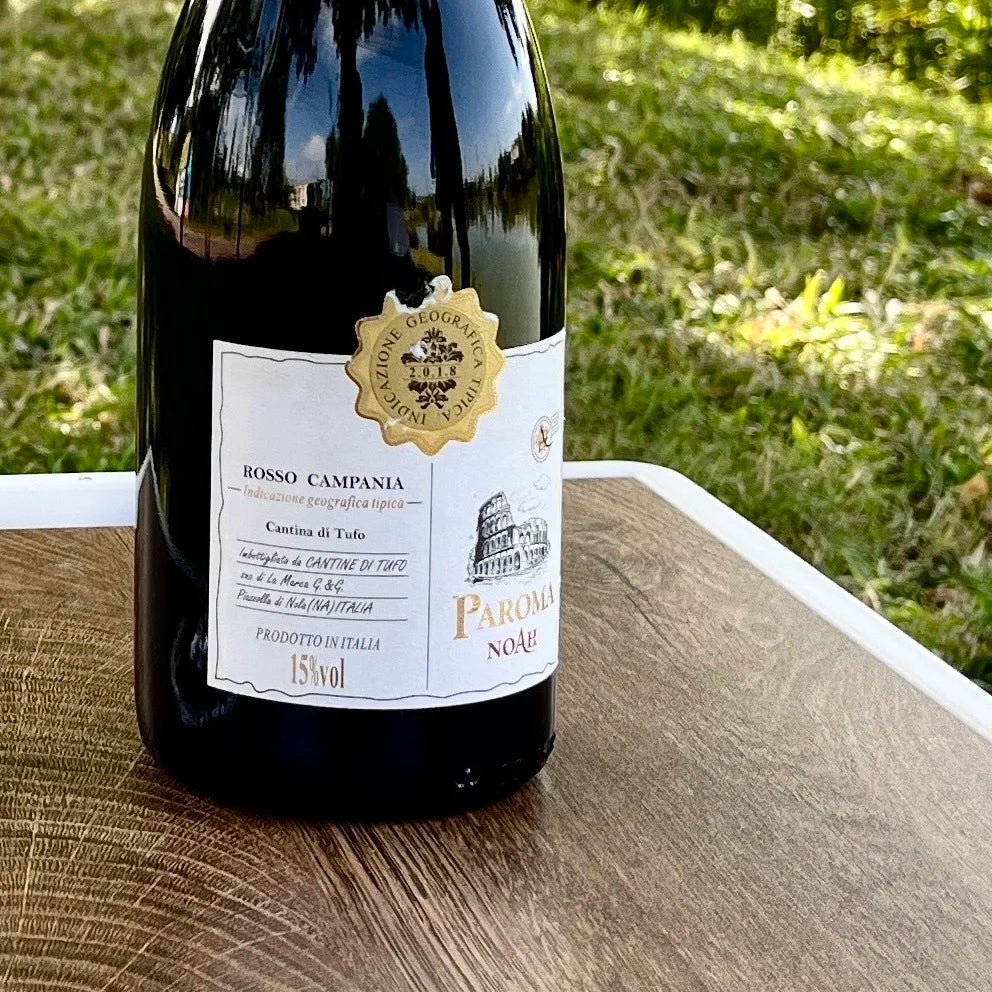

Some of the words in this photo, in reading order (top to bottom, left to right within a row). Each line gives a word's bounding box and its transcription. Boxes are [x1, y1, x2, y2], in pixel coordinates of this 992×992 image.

[406, 310, 483, 369] GEOGRAFICA
[375, 329, 426, 425] INDICAZIONE
[442, 380, 482, 423] TIPICA
[243, 465, 297, 484] ROSSO
[307, 473, 404, 490] CAMPANIA
[243, 485, 304, 505] Indicazione
[306, 495, 369, 511] geografica
[371, 497, 404, 512] tipica
[266, 521, 313, 537] Cantina
[317, 527, 330, 539] di
[333, 527, 366, 540] Tufo
[291, 556, 303, 567] da
[305, 555, 357, 572] CANTINE
[359, 559, 373, 572] DI
[377, 558, 408, 572] TUFO
[256, 571, 265, 582] di
[266, 573, 277, 584] La
[274, 596, 283, 607] di
[452, 581, 555, 641] PAROMA
[255, 627, 322, 648] PRODOTTO
[324, 635, 340, 649] IN
[340, 636, 381, 651] ITALIA
[487, 627, 538, 660] NOAH
